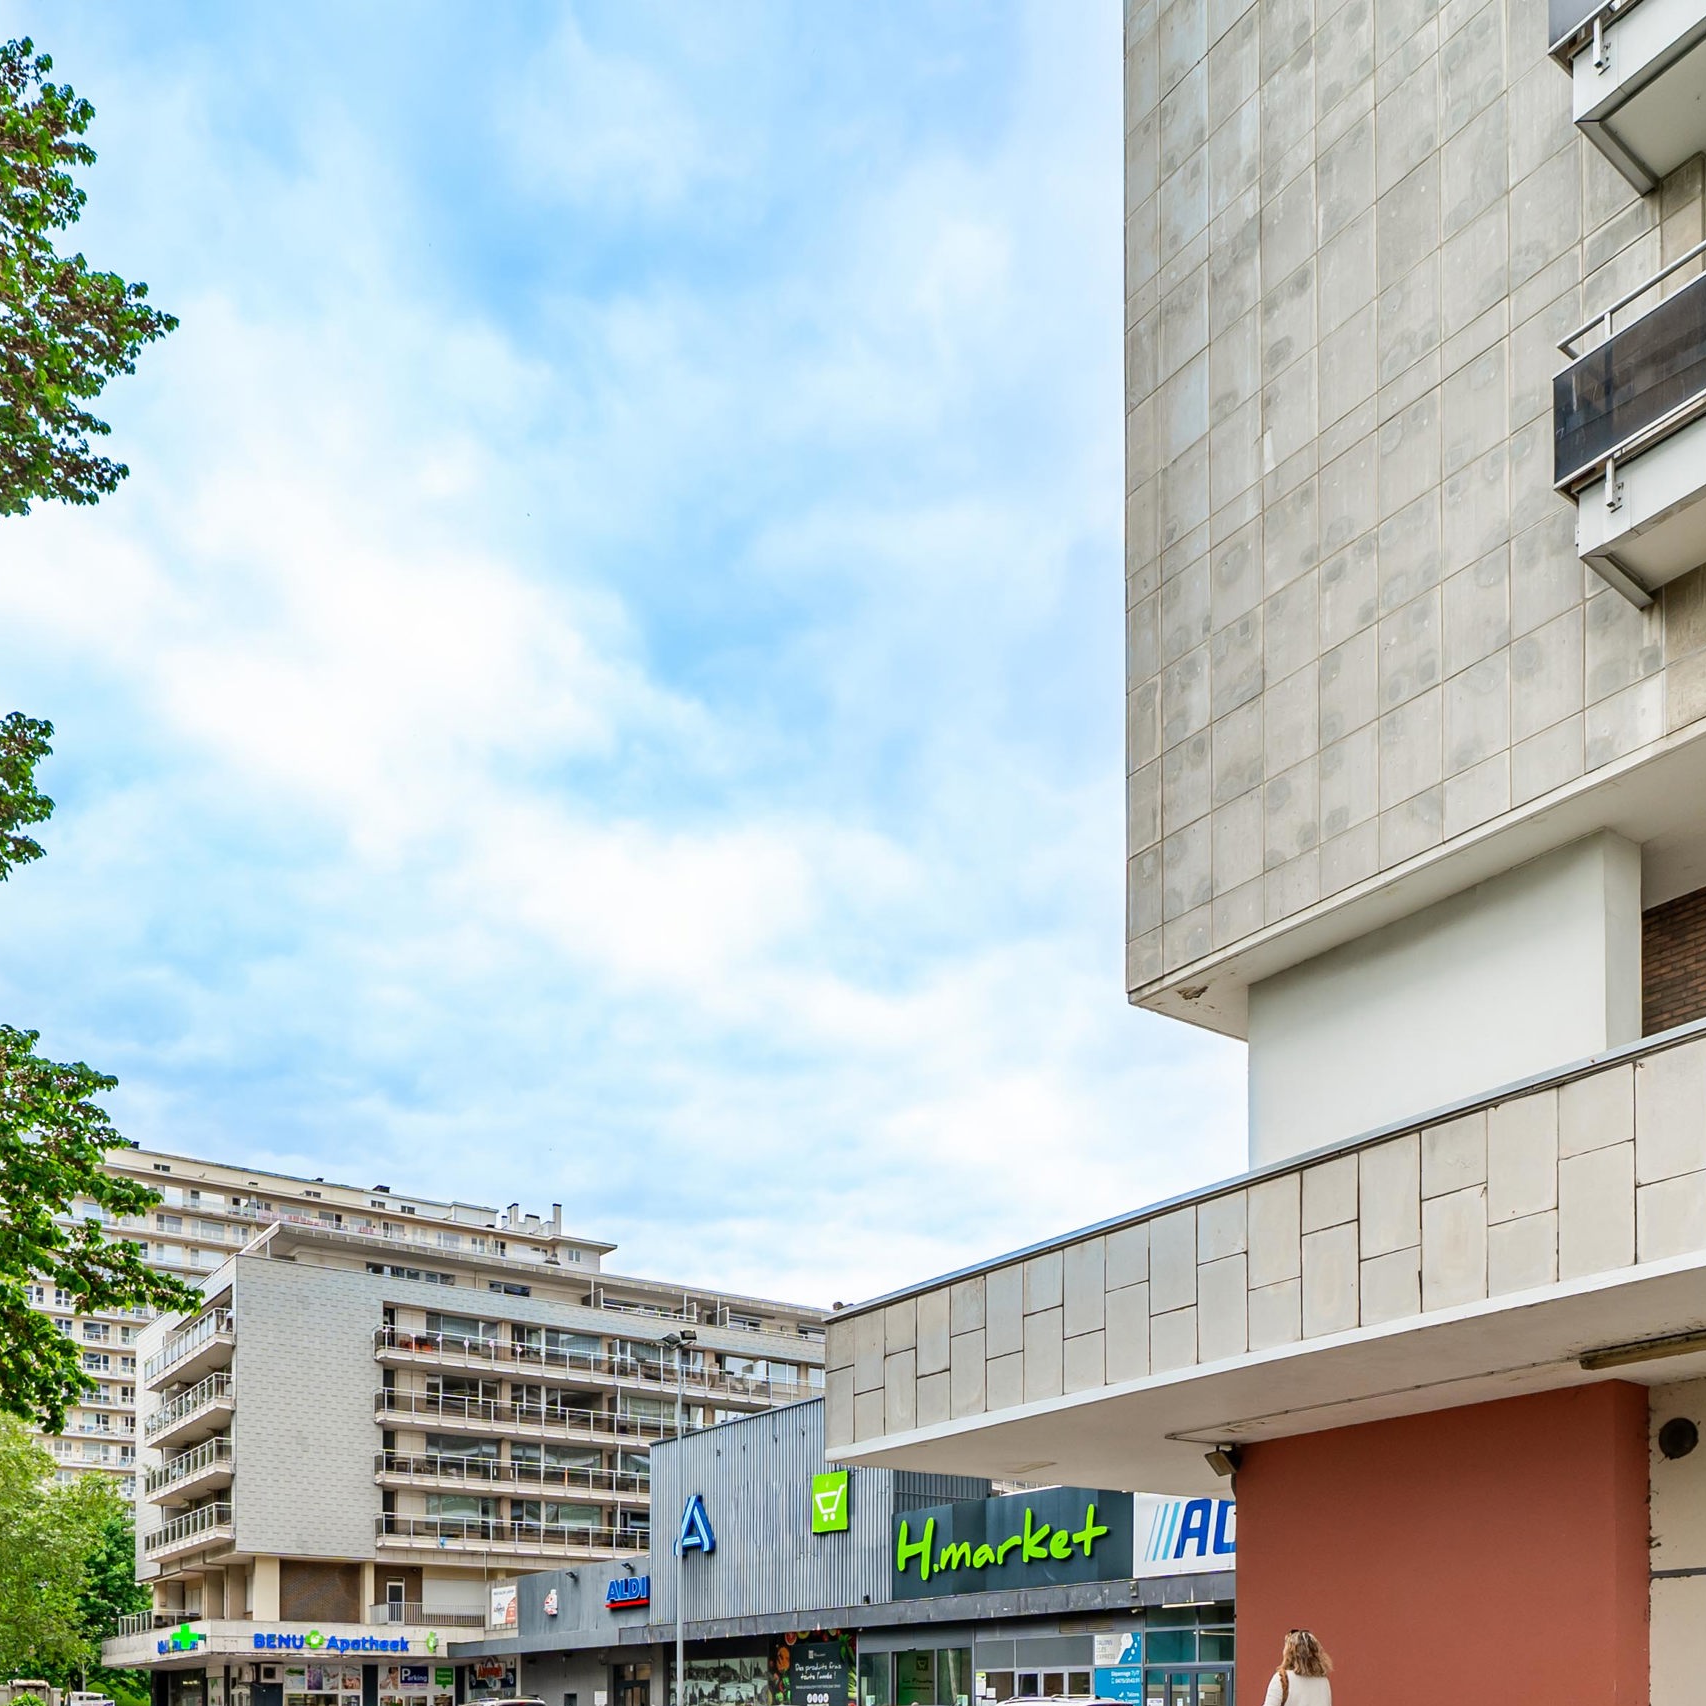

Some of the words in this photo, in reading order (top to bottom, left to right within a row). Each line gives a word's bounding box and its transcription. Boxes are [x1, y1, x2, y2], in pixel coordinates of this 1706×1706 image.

[897, 1503, 1108, 1581] H.market
[606, 1576, 650, 1602] ALDI
[253, 1633, 304, 1649] BENU
[326, 1635, 409, 1653] Apotheek
[401, 1668, 427, 1682] Parking
